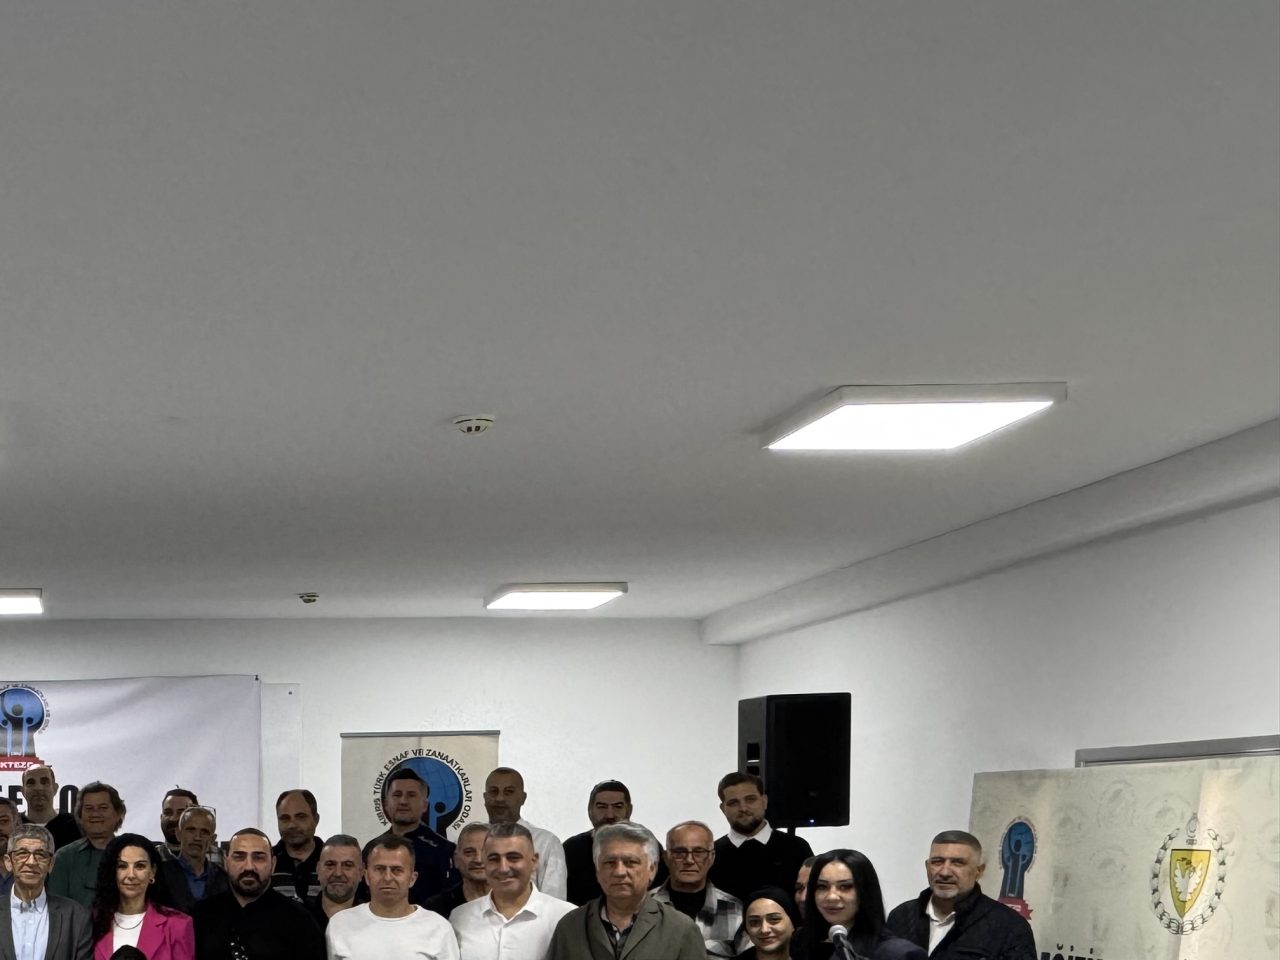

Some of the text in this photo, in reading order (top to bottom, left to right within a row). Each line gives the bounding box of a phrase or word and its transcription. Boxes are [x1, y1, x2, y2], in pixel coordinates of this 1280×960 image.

[374, 772, 386, 795] TÜRK
[384, 751, 410, 771] ESNAF
[426, 749, 472, 802] ZANAATKARLAR
